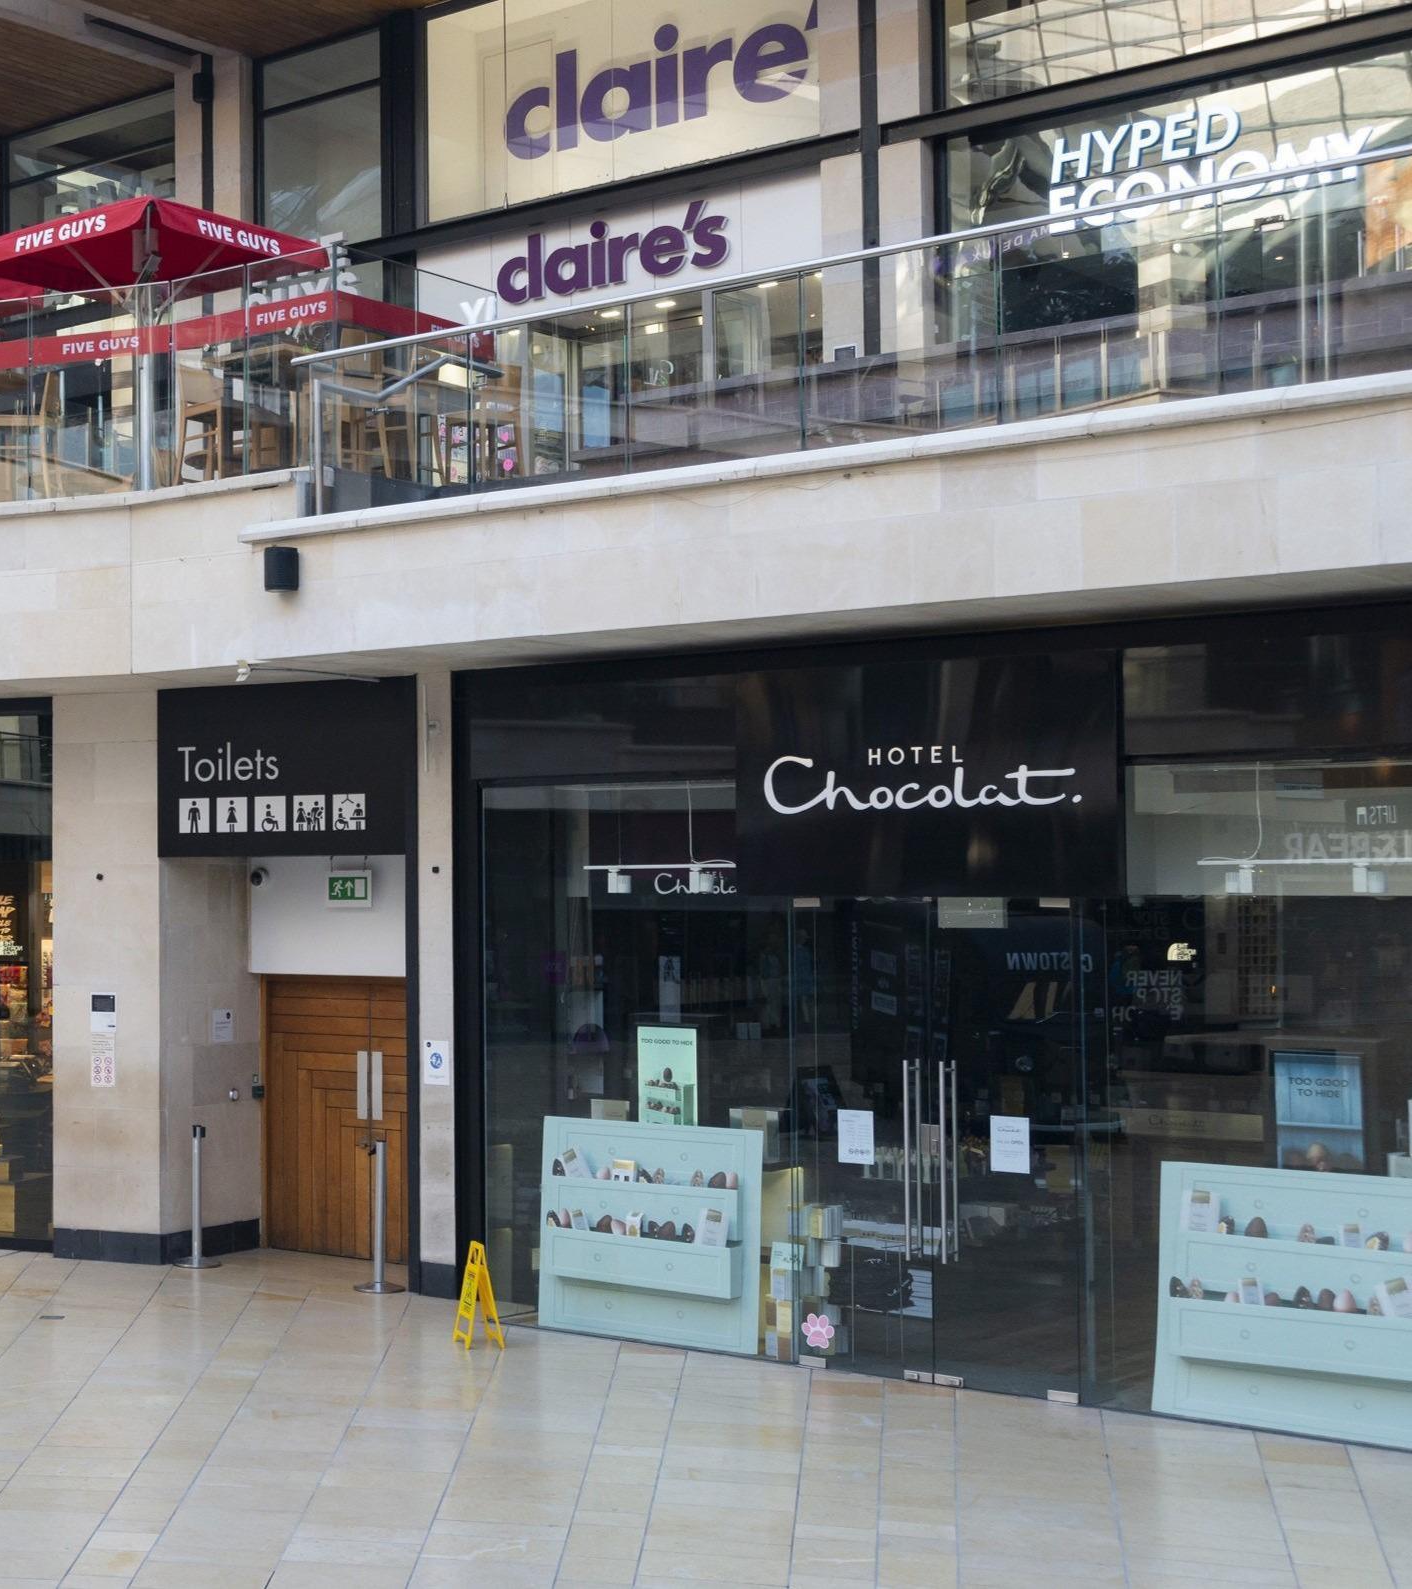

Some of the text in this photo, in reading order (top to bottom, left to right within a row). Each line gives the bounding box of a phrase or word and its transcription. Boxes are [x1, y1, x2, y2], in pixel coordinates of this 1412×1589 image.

[1051, 106, 1242, 184] HYPED
[1049, 126, 1374, 236] ECONOMY
[15, 214, 106, 252] FIVE GUYS
[197, 218, 281, 256] FIVE GUYS
[497, 200, 730, 305] claire's
[256, 301, 327, 326] FIVE GUYS
[62, 336, 139, 355] FIVE GUYS
[177, 741, 279, 782] Toilets
[868, 746, 963, 766] HOTEL
[1288, 1076, 1349, 1088] TOO GOOD
[1297, 1088, 1313, 1097] TO
